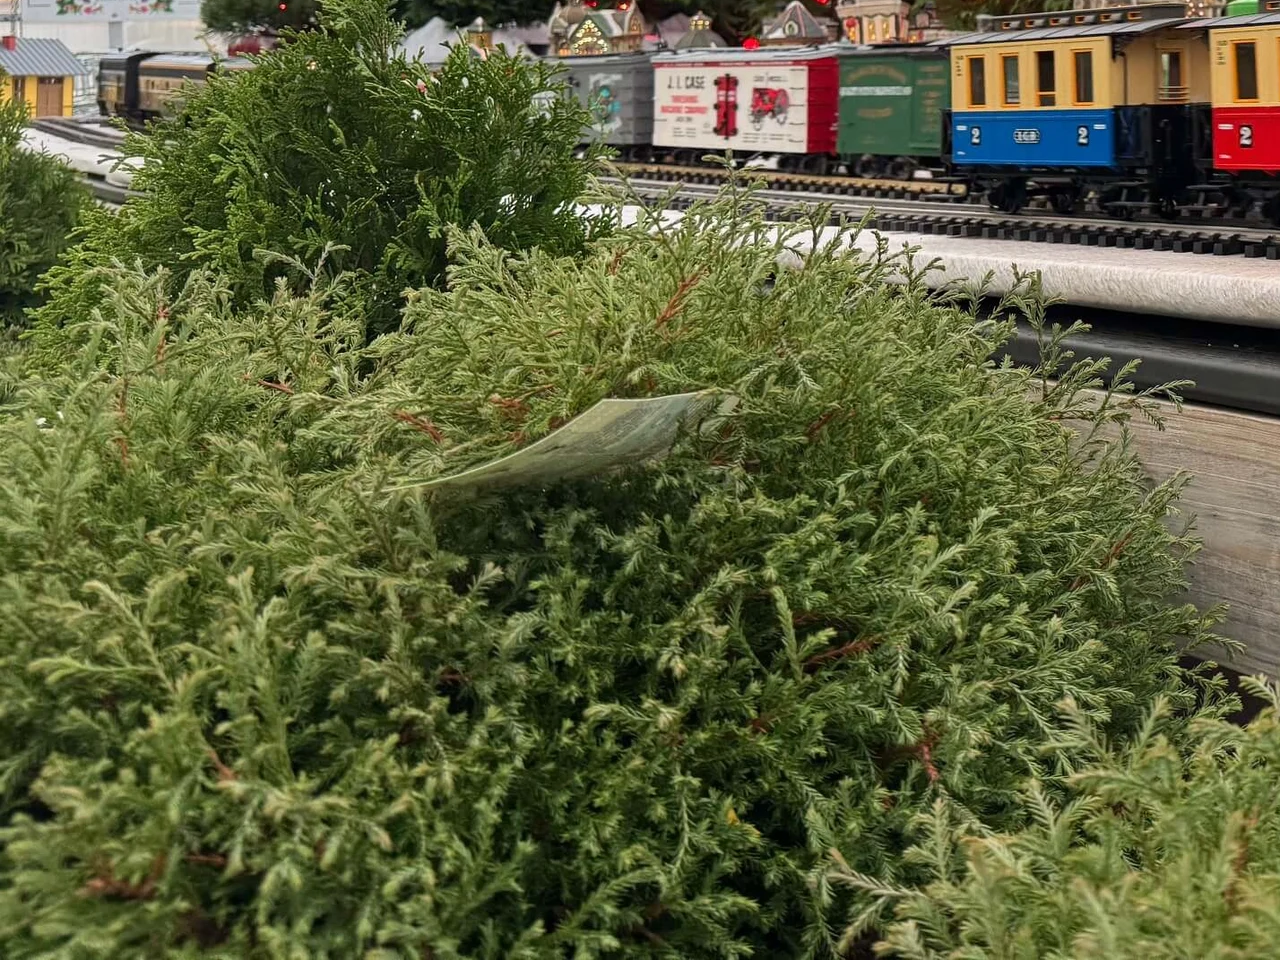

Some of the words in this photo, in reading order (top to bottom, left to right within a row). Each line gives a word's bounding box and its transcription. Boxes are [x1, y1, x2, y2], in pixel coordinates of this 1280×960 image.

[684, 75, 705, 90] CASE
[971, 127, 981, 144] 2
[1077, 126, 1089, 144] 2
[1239, 126, 1252, 145] 2
